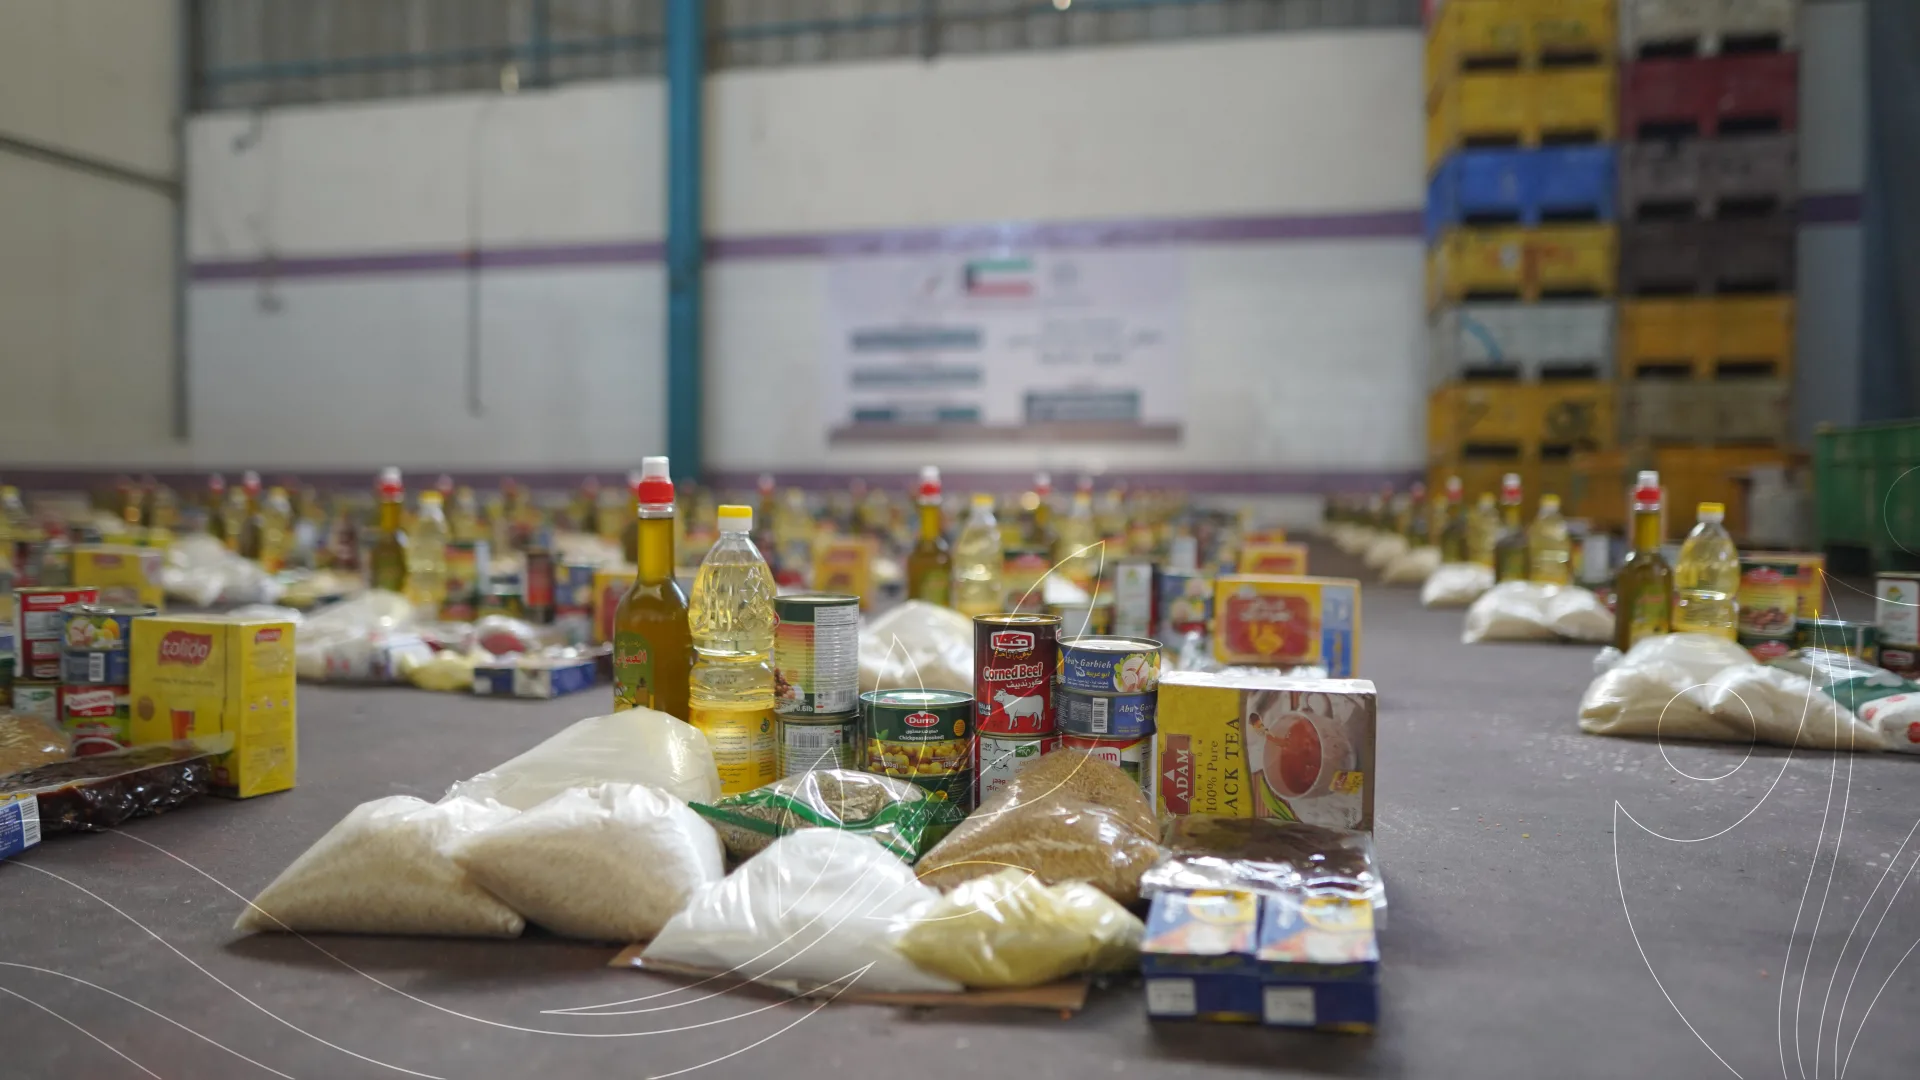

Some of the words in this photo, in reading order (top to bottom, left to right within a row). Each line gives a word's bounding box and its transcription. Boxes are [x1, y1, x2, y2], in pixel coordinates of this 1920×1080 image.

[983, 664, 1018, 681] Corned
[1019, 661, 1044, 678] Beef
[1080, 659, 1112, 669] Garbieh
[909, 716, 935, 724] Durra
[1119, 704, 1134, 713] Abu
[1225, 717, 1240, 761] TEA
[1207, 740, 1219, 772] Pure
[1176, 748, 1189, 803] ADAM
[1206, 776, 1218, 812] 100%
[1224, 767, 1239, 817] ACK
